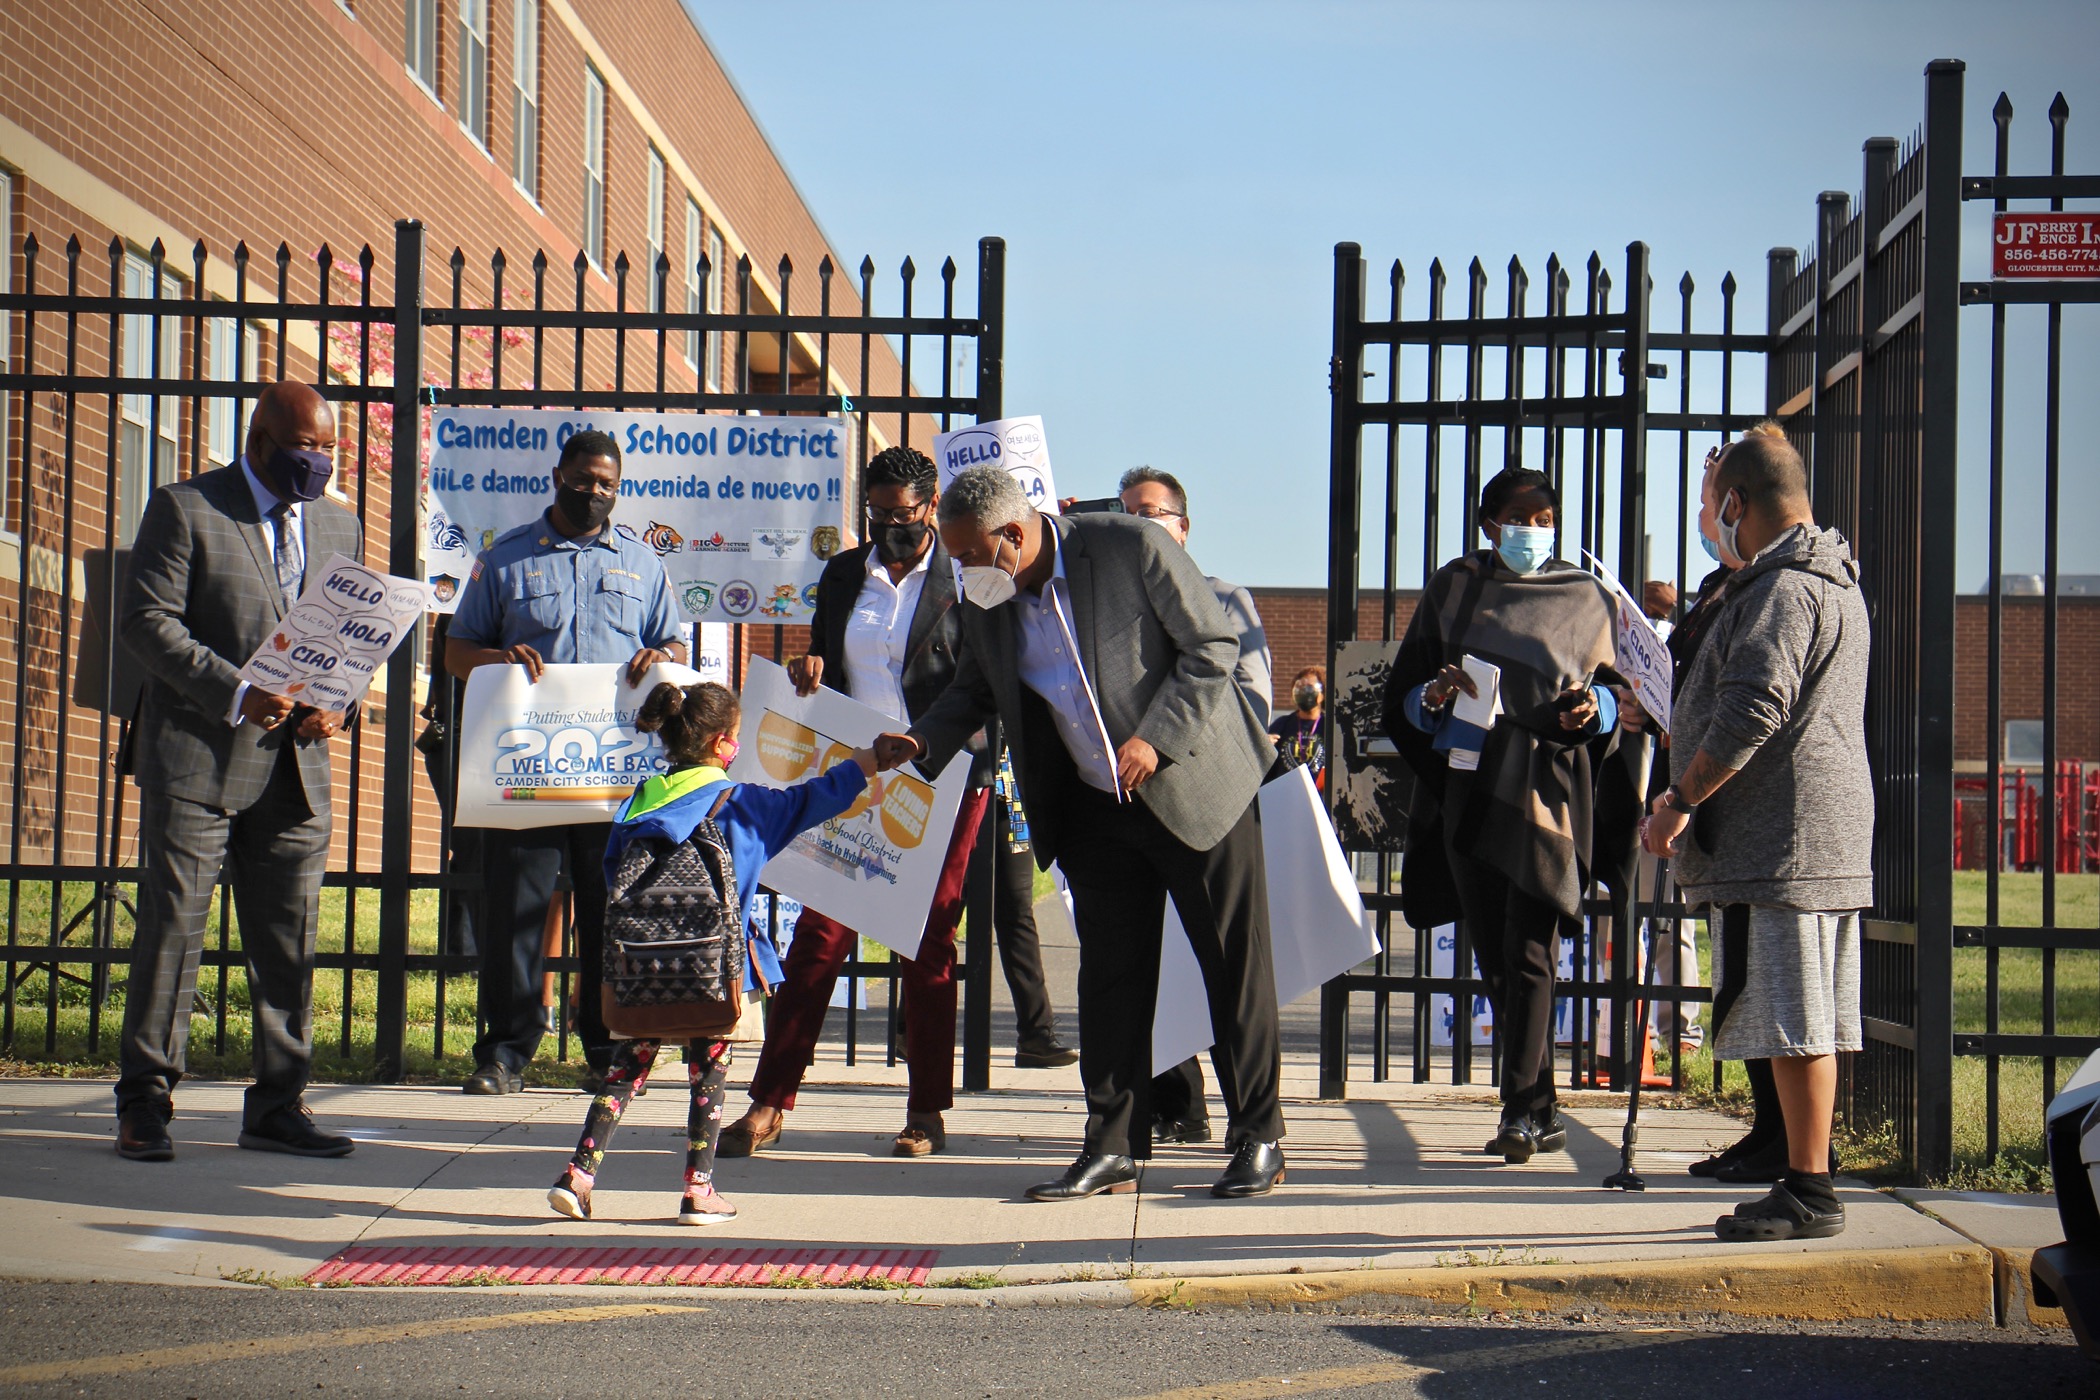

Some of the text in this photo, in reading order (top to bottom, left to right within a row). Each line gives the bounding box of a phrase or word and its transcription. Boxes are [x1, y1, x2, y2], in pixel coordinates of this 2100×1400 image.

[2004, 249, 2100, 261] 856-456-774
[437, 418, 548, 450] Camden
[625, 423, 717, 455] School
[727, 426, 838, 458] District
[947, 441, 1002, 469] HELLO
[482, 468, 550, 495] damos
[616, 474, 710, 499] nvenida
[717, 475, 745, 499] de
[752, 479, 820, 501] nuevo
[1020, 477, 1045, 498] LA
[692, 539, 711, 547] BIG
[325, 573, 384, 605] HELLO
[338, 620, 393, 647] HOLA
[290, 645, 338, 671] CIAO
[700, 656, 721, 668] OLA
[1630, 629, 1651, 670] CIAO
[251, 659, 290, 680] BONJOUR
[343, 658, 374, 673] HALLO
[311, 681, 349, 698] KAMUSTA
[575, 709, 628, 724] Students
[496, 727, 664, 774] 202
[760, 743, 806, 764] SUPPORT
[512, 755, 668, 774] WELCOME BAC
[495, 777, 549, 787] CAMDEN
[553, 776, 581, 787] CITY
[585, 775, 636, 786] SCHOOL
[892, 781, 929, 821] LOVING
[881, 794, 923, 839] TEACHERS
[816, 834, 834, 853] back
[834, 844, 843, 856] to
[843, 847, 866, 868] Hybrid
[823, 816, 903, 864] School District
